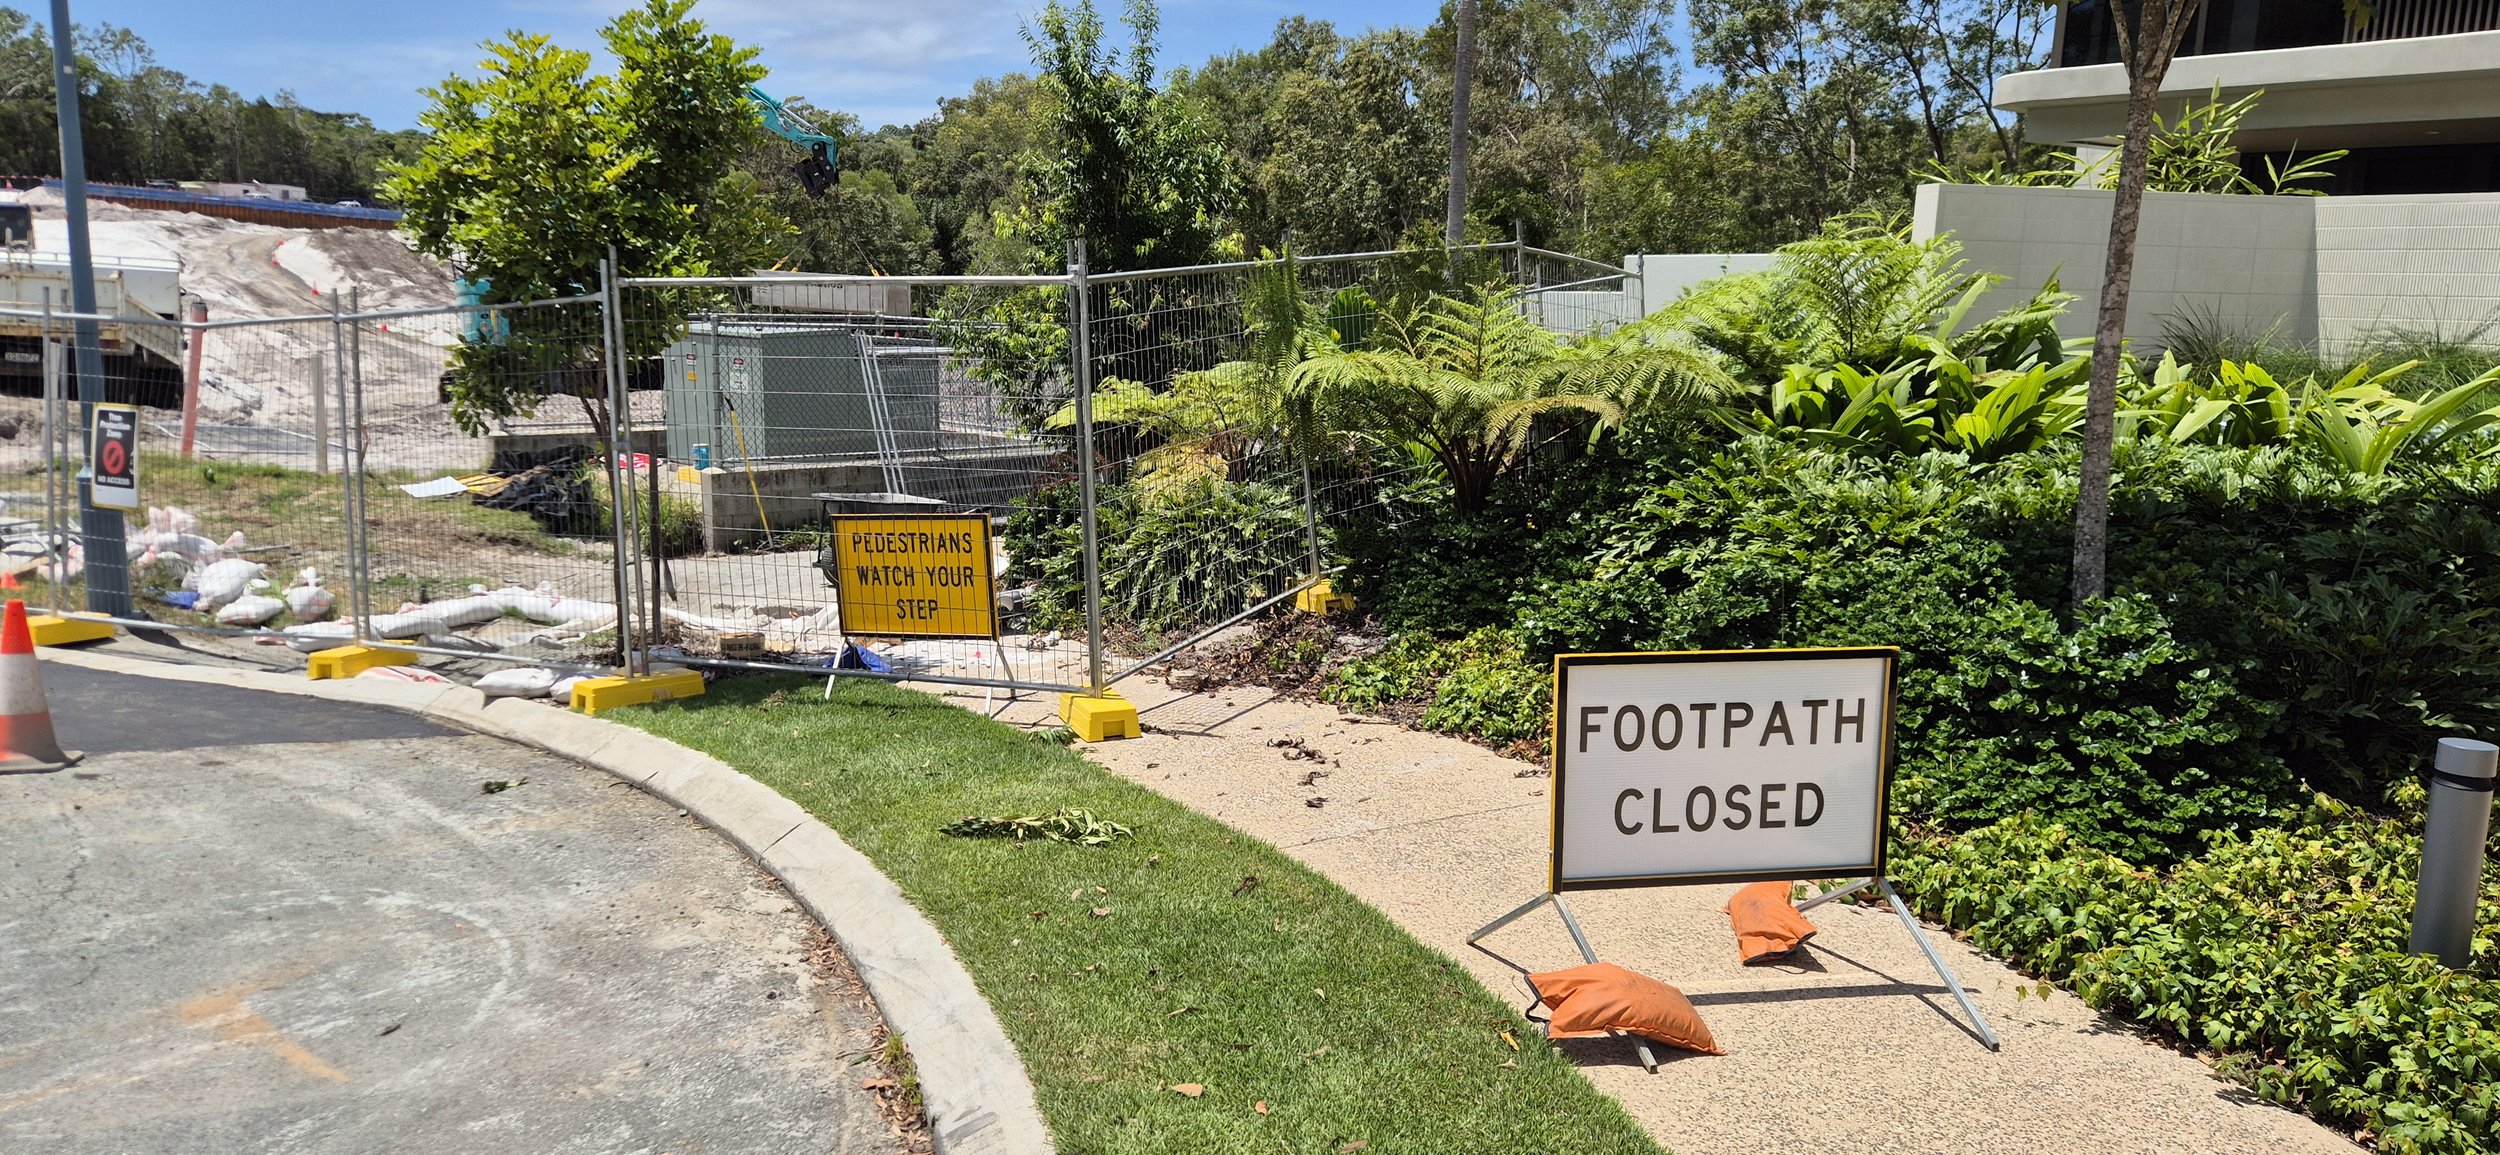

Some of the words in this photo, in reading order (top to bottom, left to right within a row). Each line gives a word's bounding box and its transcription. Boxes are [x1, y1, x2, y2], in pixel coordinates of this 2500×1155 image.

[97, 475, 106, 483] NO
[107, 476, 130, 486] ACCESS
[852, 532, 973, 554] PEDESTRIANS
[856, 565, 915, 587] WATCH
[926, 566, 974, 588] YOUR
[896, 598, 938, 620] STEP
[1579, 698, 1866, 753] FOOTPATH
[1614, 782, 1825, 836] CLOSED
